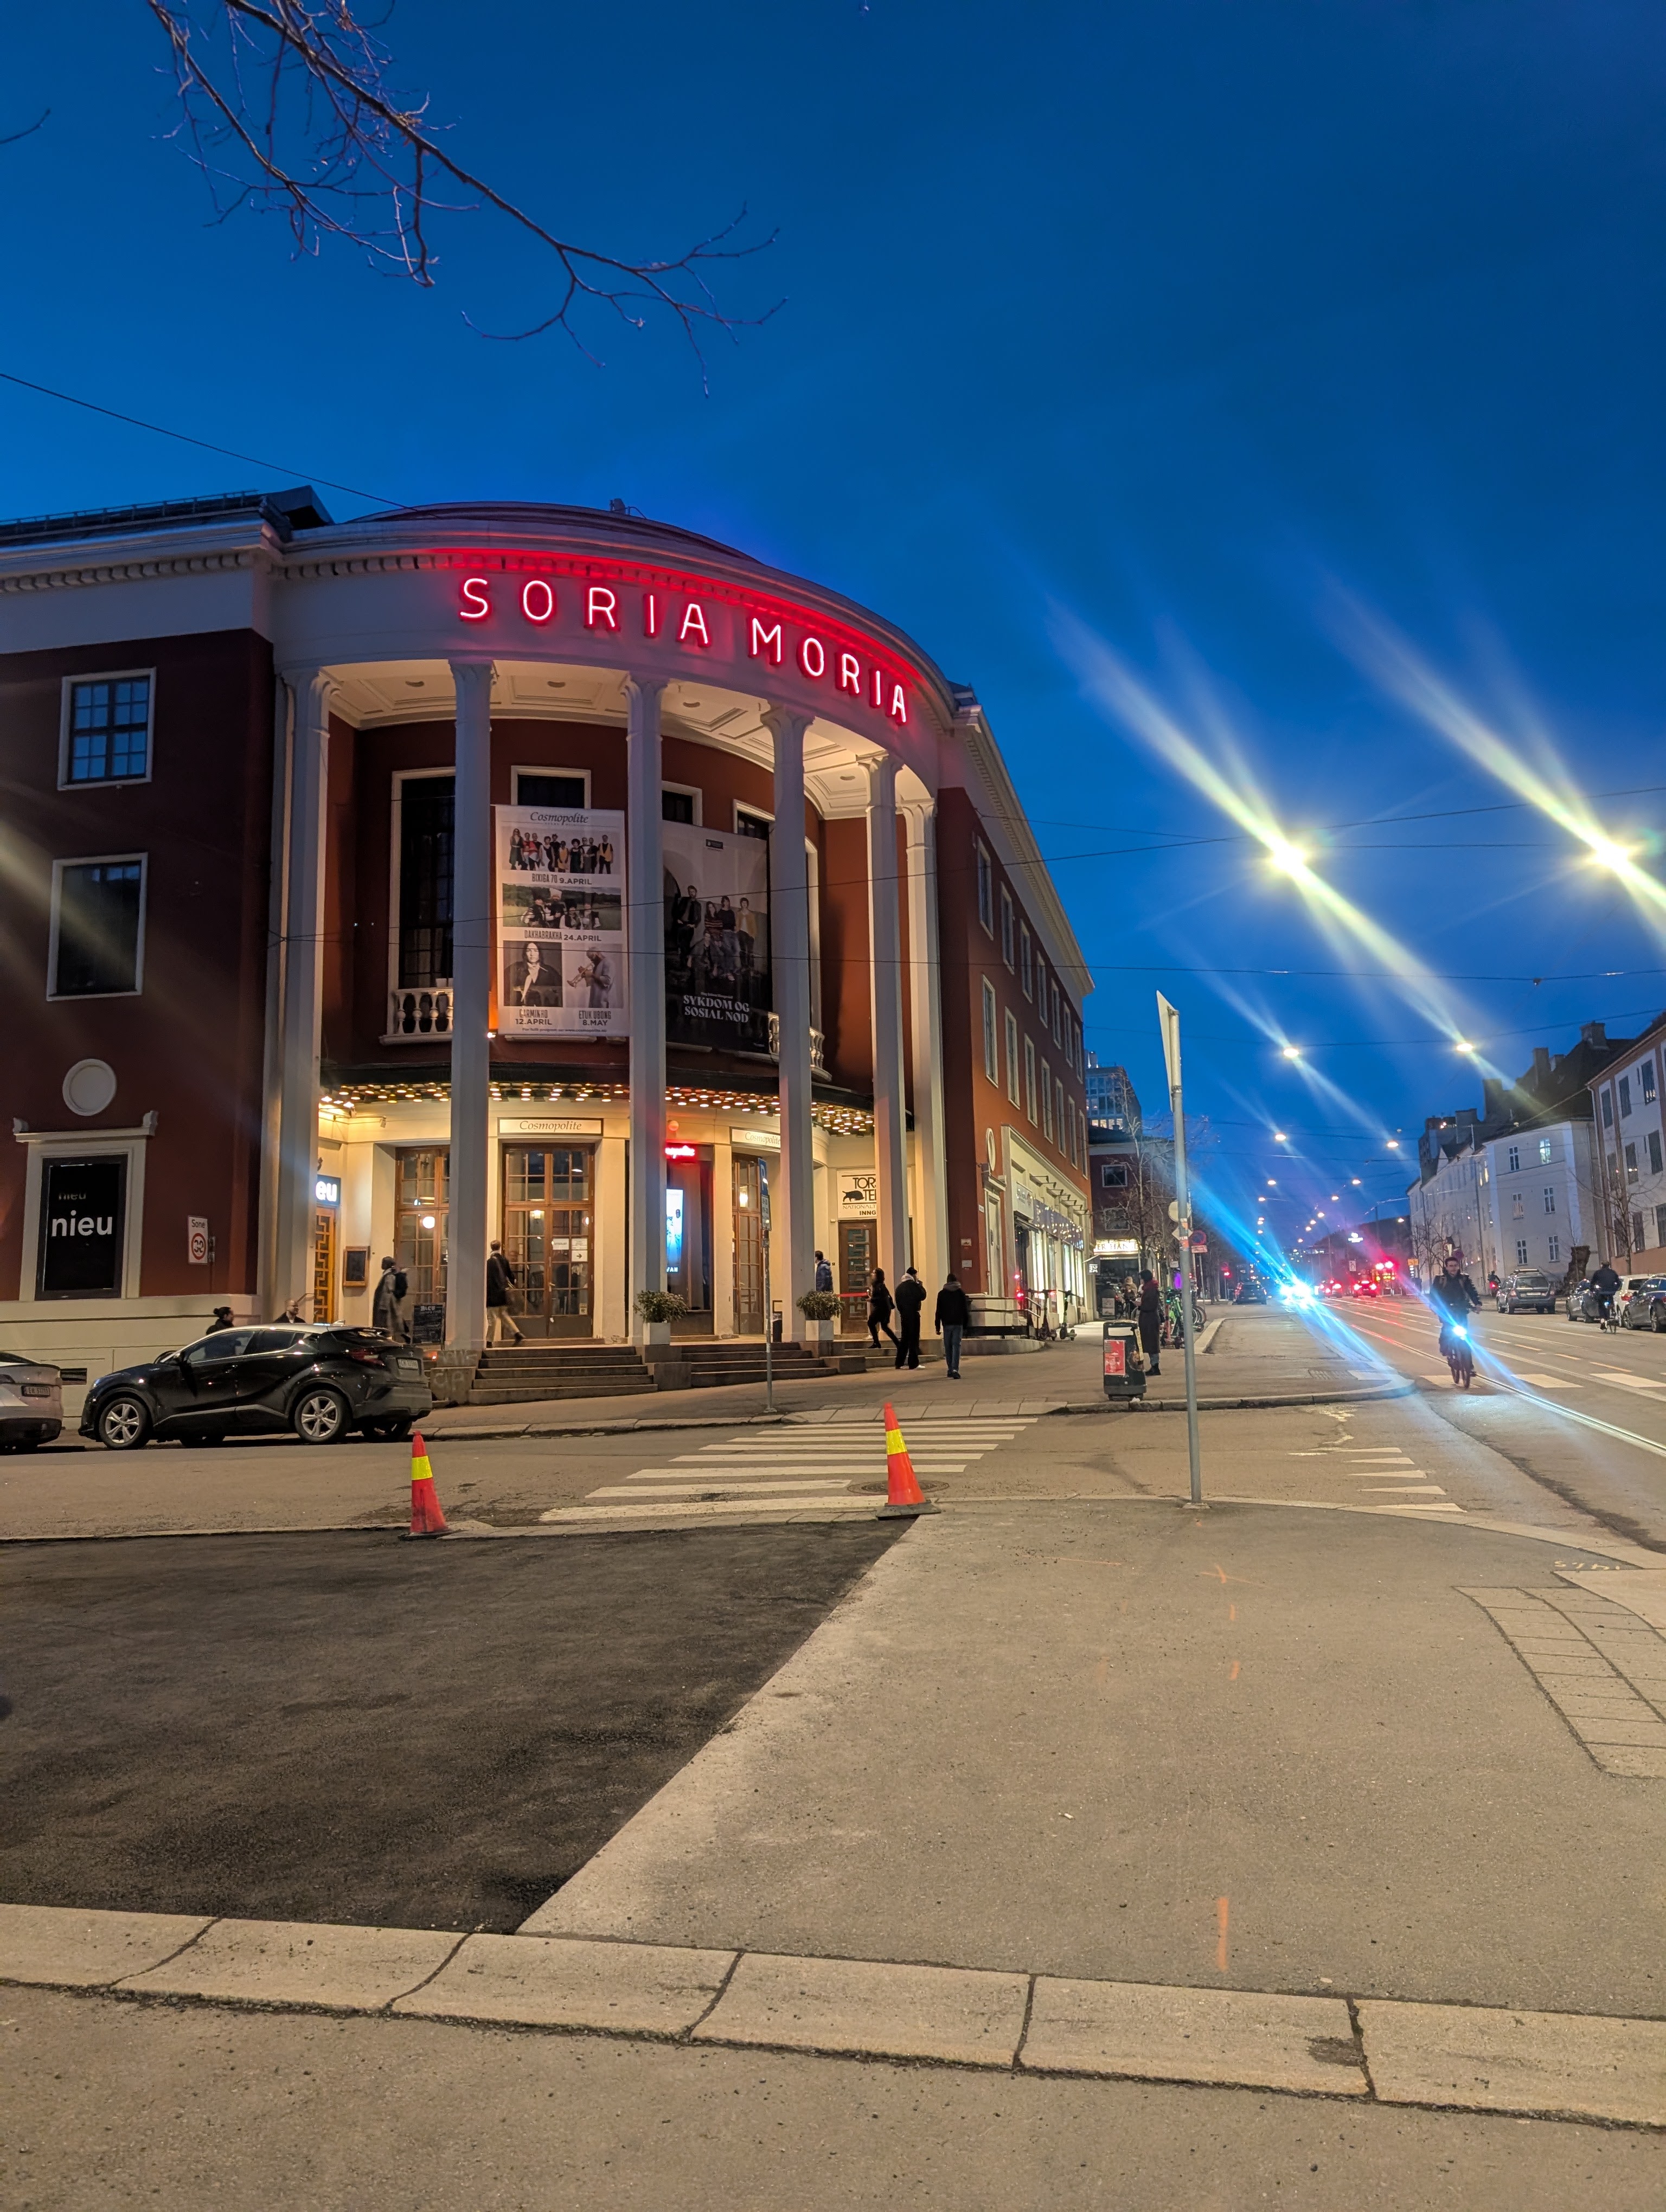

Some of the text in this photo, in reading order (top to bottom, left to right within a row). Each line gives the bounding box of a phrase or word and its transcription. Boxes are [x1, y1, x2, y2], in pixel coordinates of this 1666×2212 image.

[459, 577, 907, 725] SORIA MORIA
[530, 812, 589, 825] Cosmopolite
[683, 994, 732, 1010] SYKDOM
[734, 1002, 749, 1012] OG
[684, 1006, 723, 1020] SOSIAL
[520, 1121, 582, 1132] Cosmopolite
[760, 1164, 766, 1191] P
[52, 1210, 112, 1237] nieu
[191, 1219, 205, 1228] Sone
